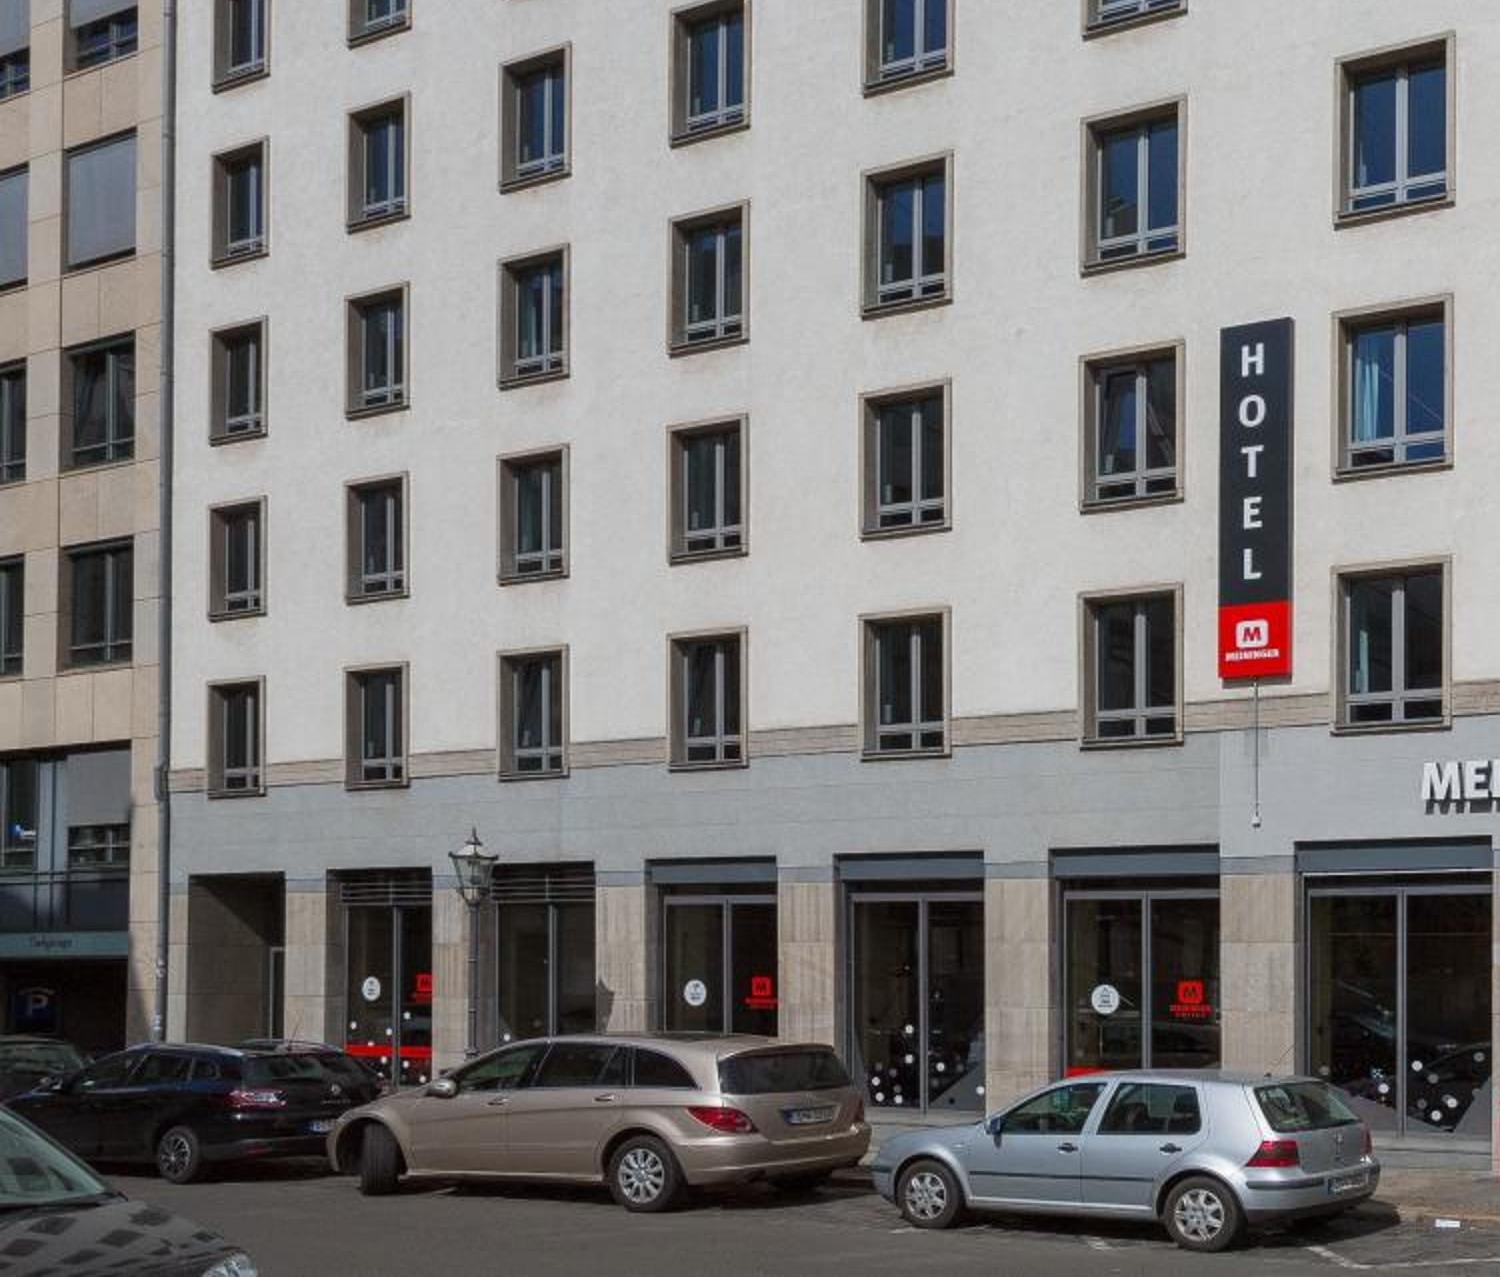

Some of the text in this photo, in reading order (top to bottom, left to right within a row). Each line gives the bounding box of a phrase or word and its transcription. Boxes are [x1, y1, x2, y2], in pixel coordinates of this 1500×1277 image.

[1238, 342, 1266, 580] HOTEL
[1242, 625, 1262, 643] M
[27, 994, 48, 1018] P
